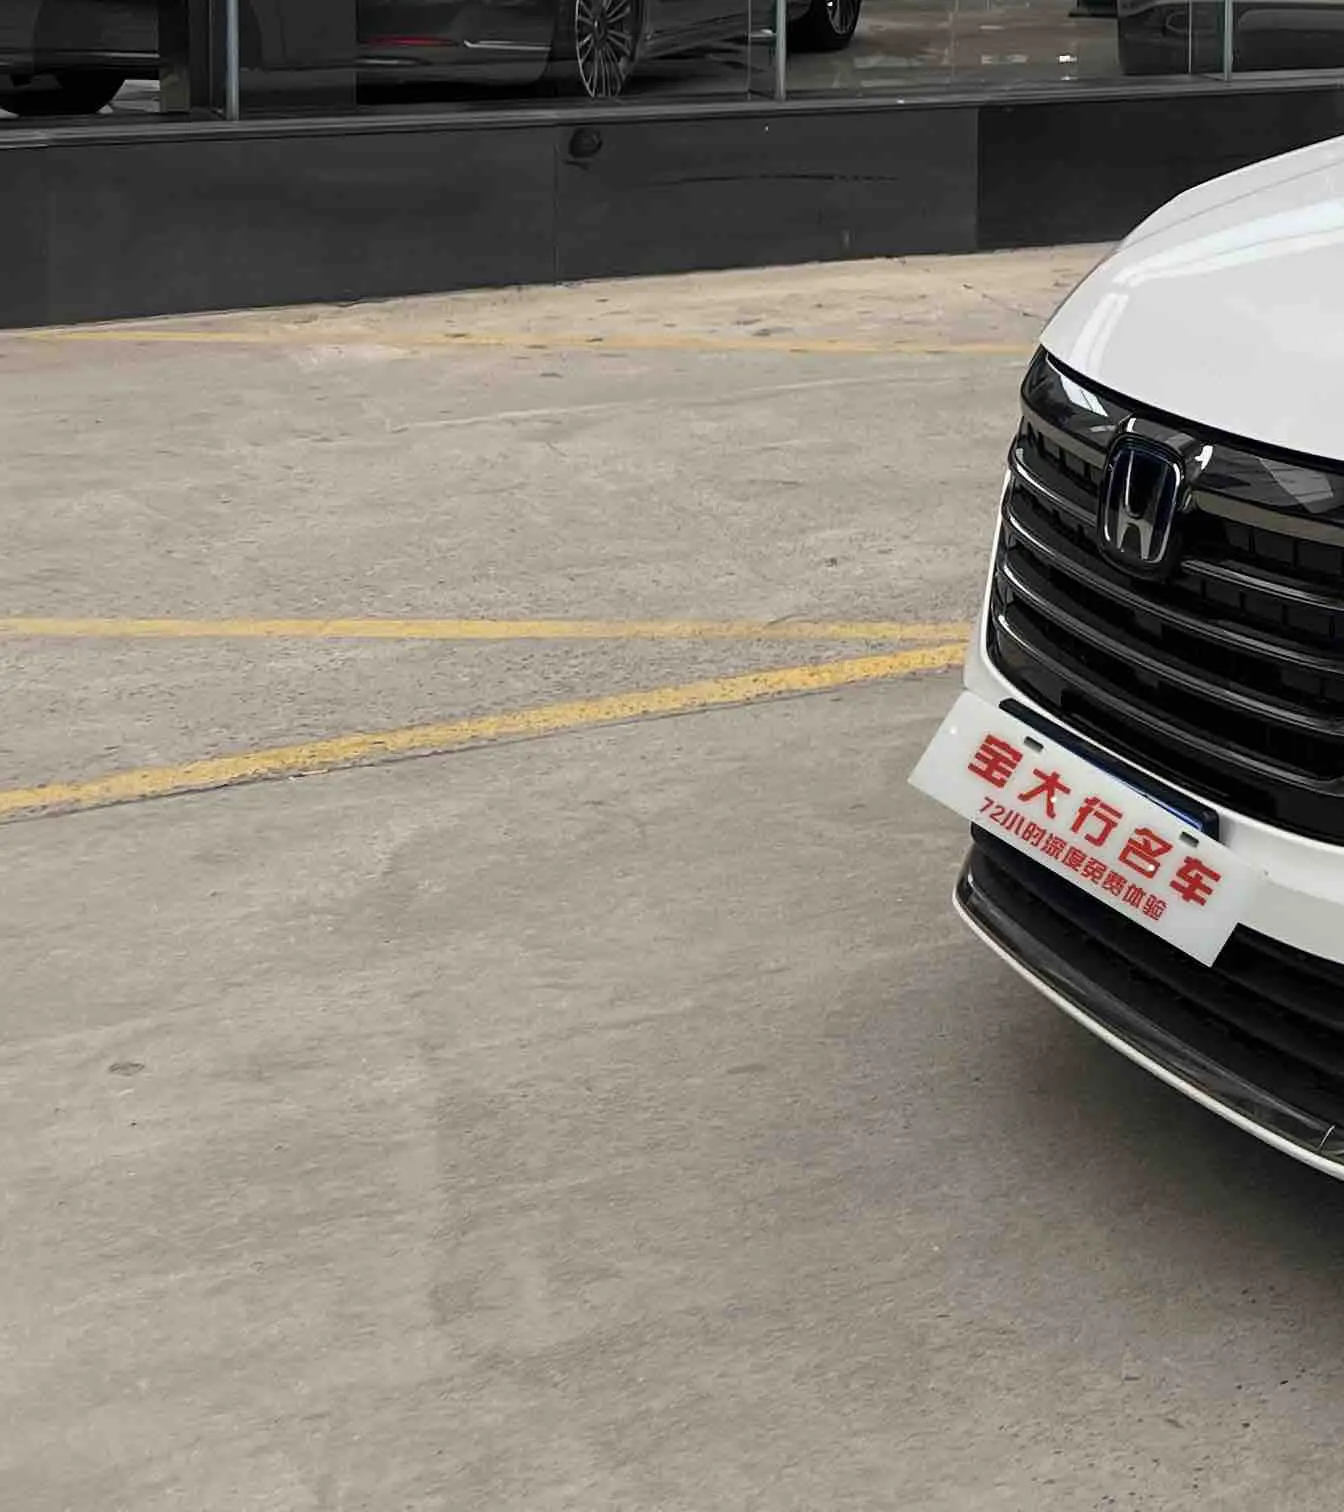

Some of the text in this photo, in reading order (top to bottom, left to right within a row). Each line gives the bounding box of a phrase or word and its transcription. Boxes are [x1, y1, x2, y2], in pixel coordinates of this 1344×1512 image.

[967, 733, 1222, 908] 宝大行名车
